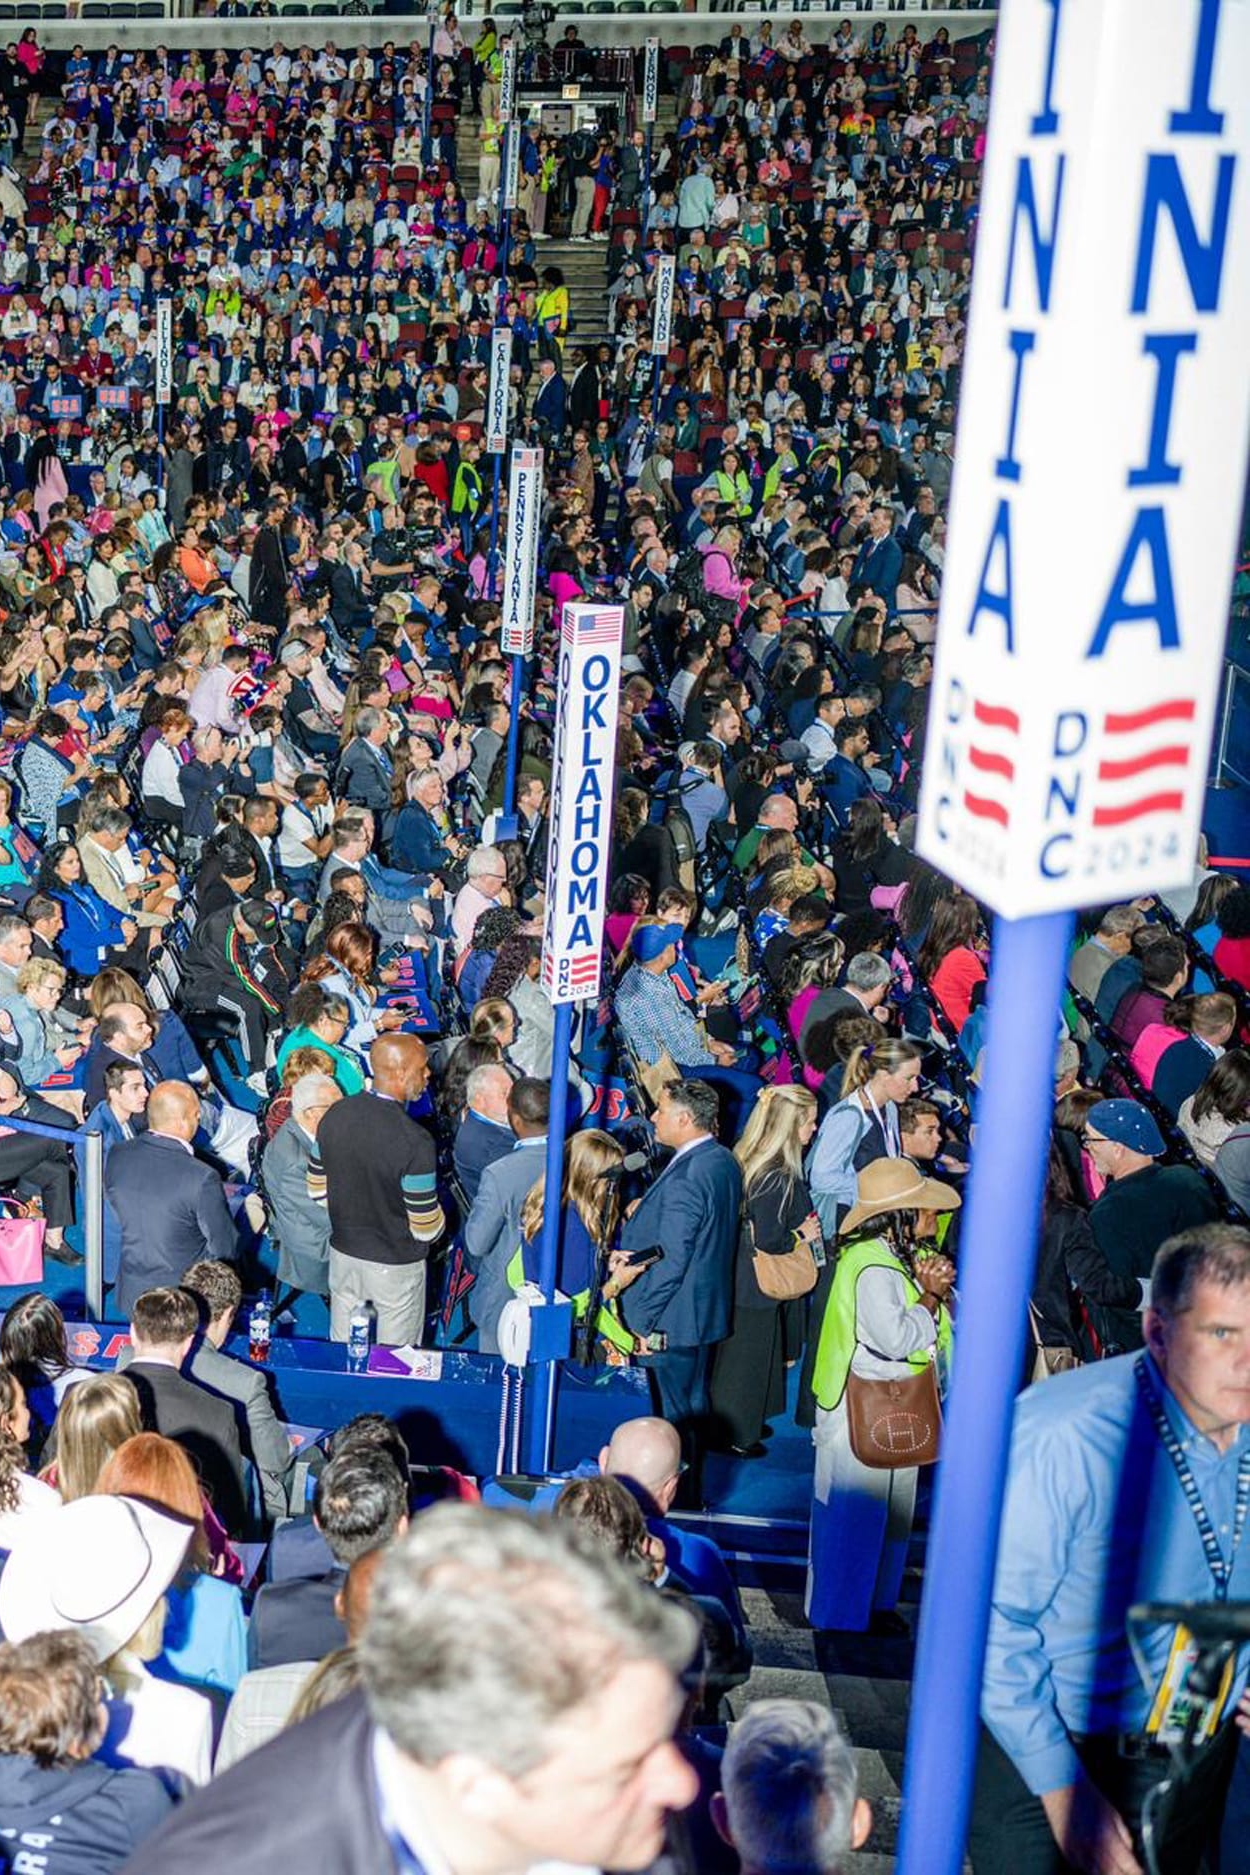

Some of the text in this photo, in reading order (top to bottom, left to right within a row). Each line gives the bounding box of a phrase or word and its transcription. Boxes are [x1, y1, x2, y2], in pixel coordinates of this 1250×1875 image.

[502, 50, 510, 109] ALASKA
[646, 48, 656, 110] VERMONT
[657, 267, 672, 341] MARYLAND
[160, 311, 169, 388] ILLINOIS
[493, 343, 507, 435] CALIFORNIA
[510, 472, 527, 624] PENNSYLVANIA
[545, 652, 570, 948] OKLAHOMA
[565, 654, 612, 951] OKLAHOMA
[1039, 710, 1089, 880] DNC
[557, 957, 571, 998] DNC
[570, 984, 597, 997] 2024
